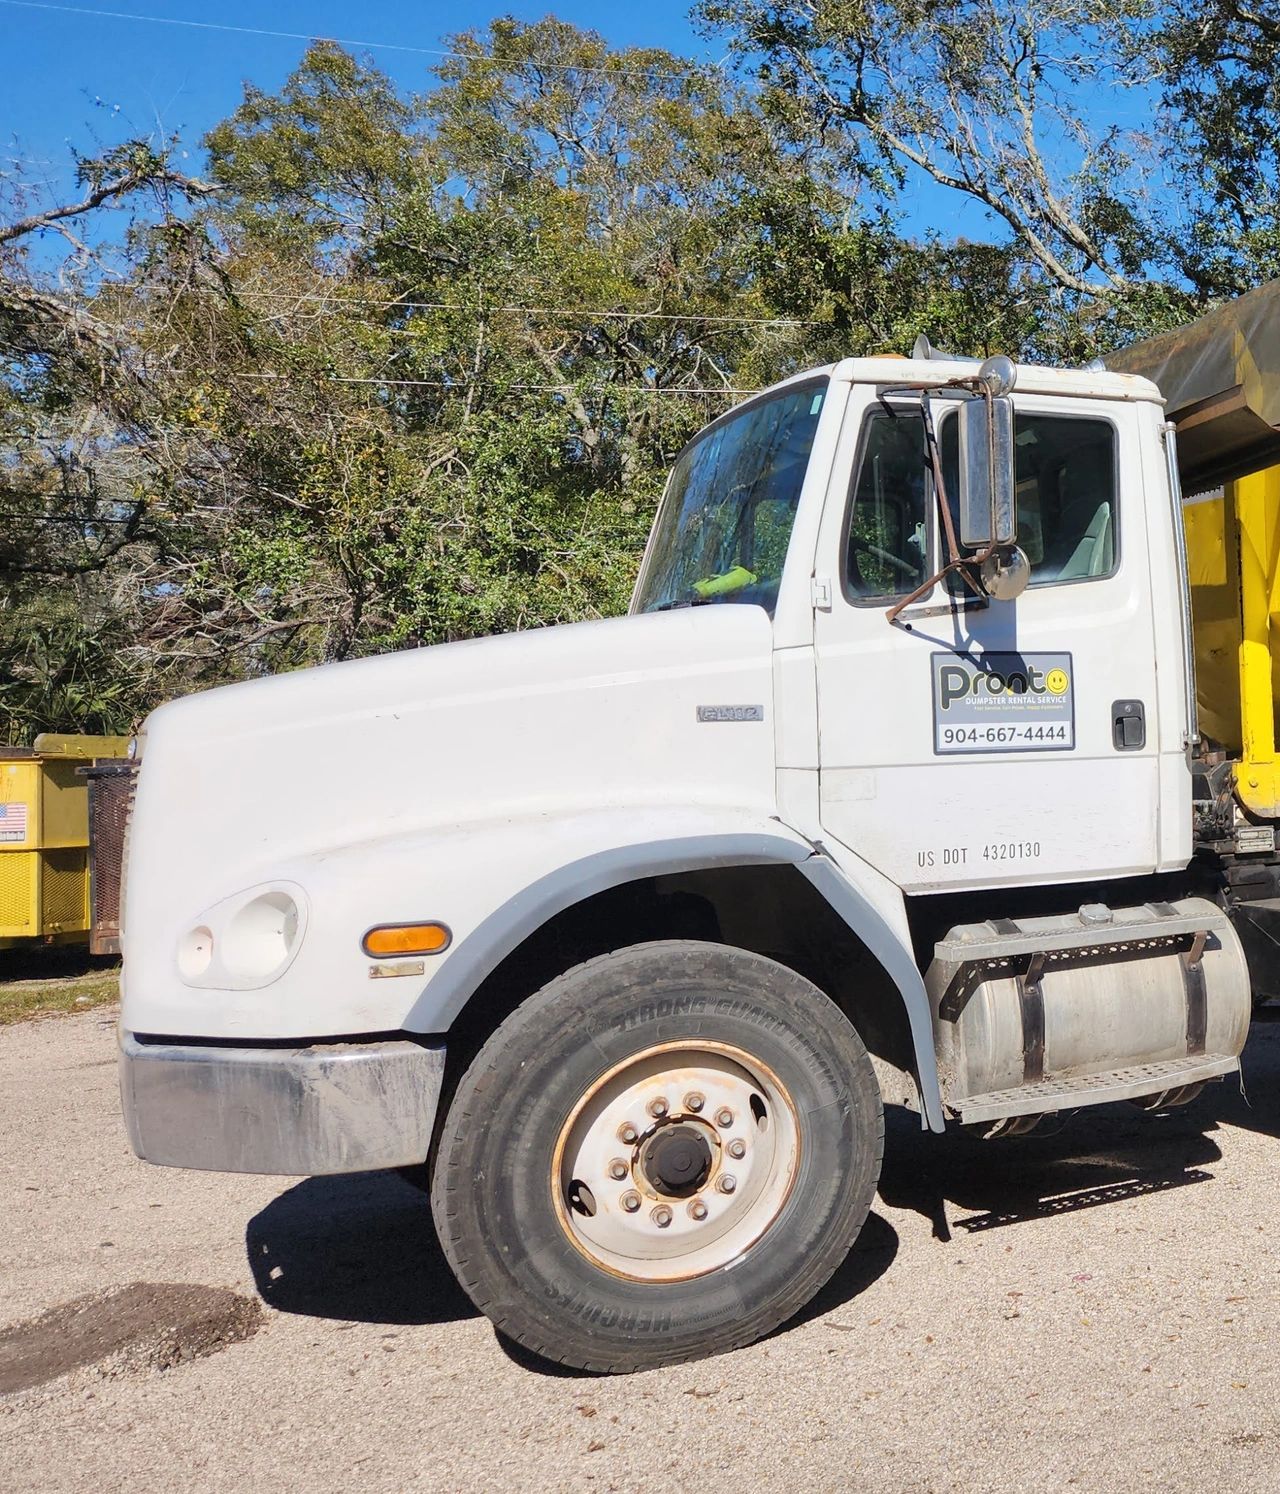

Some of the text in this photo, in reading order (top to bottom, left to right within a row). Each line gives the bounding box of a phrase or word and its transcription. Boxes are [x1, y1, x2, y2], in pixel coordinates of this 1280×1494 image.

[965, 695, 1067, 705] DUMPSTER RENTAL SERVICE
[944, 727, 1066, 743] 904-667-4444
[918, 841, 1041, 868] US DOT 4320130
